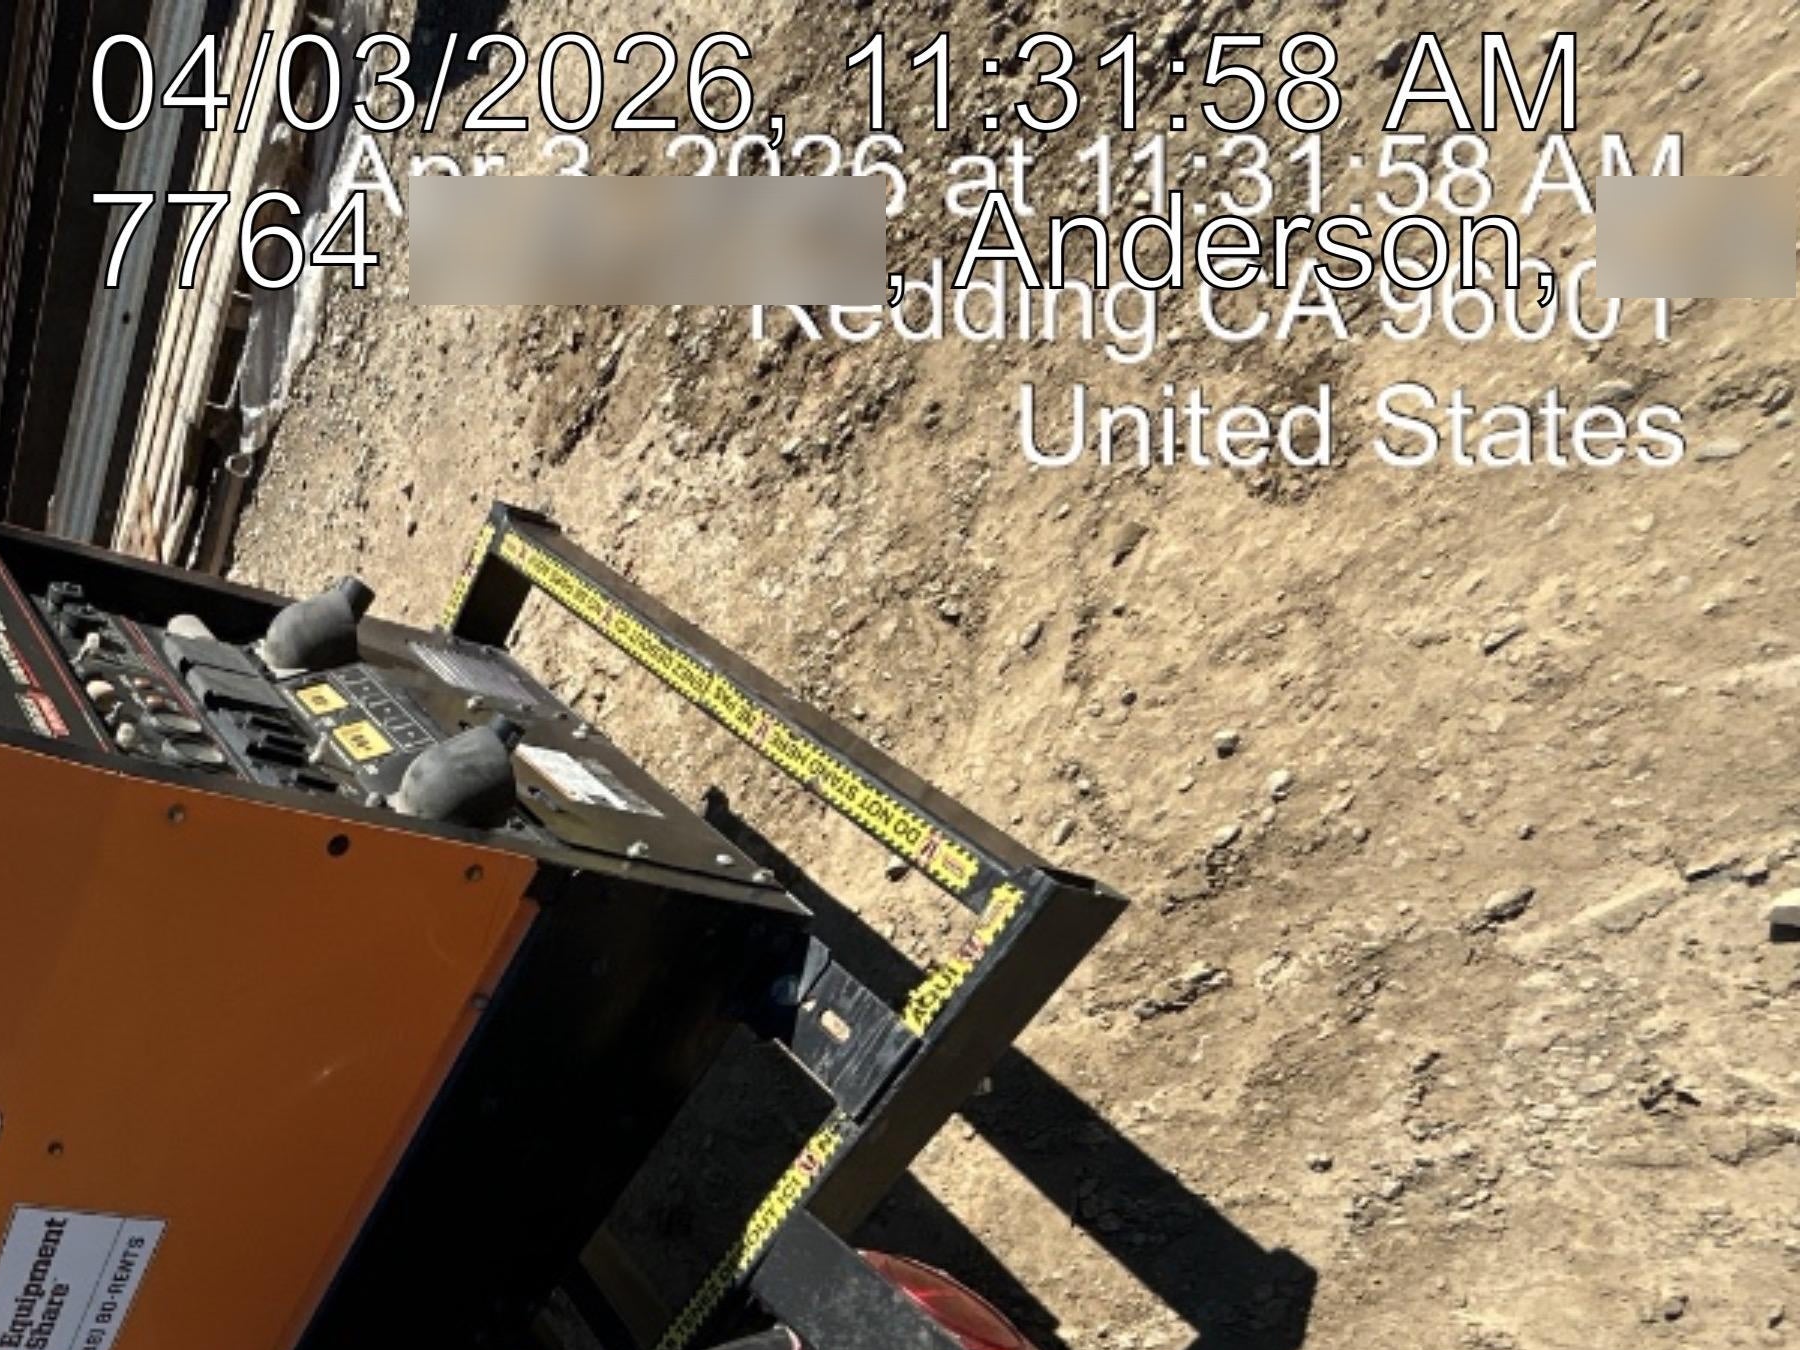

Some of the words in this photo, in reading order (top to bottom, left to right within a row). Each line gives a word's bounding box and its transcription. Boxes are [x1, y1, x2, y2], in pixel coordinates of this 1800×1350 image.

[860, 796, 894, 825] NOT
[893, 818, 921, 844] DO
[95, 1236, 145, 1323] 80-RENTS
[26, 1283, 69, 1350] Share
